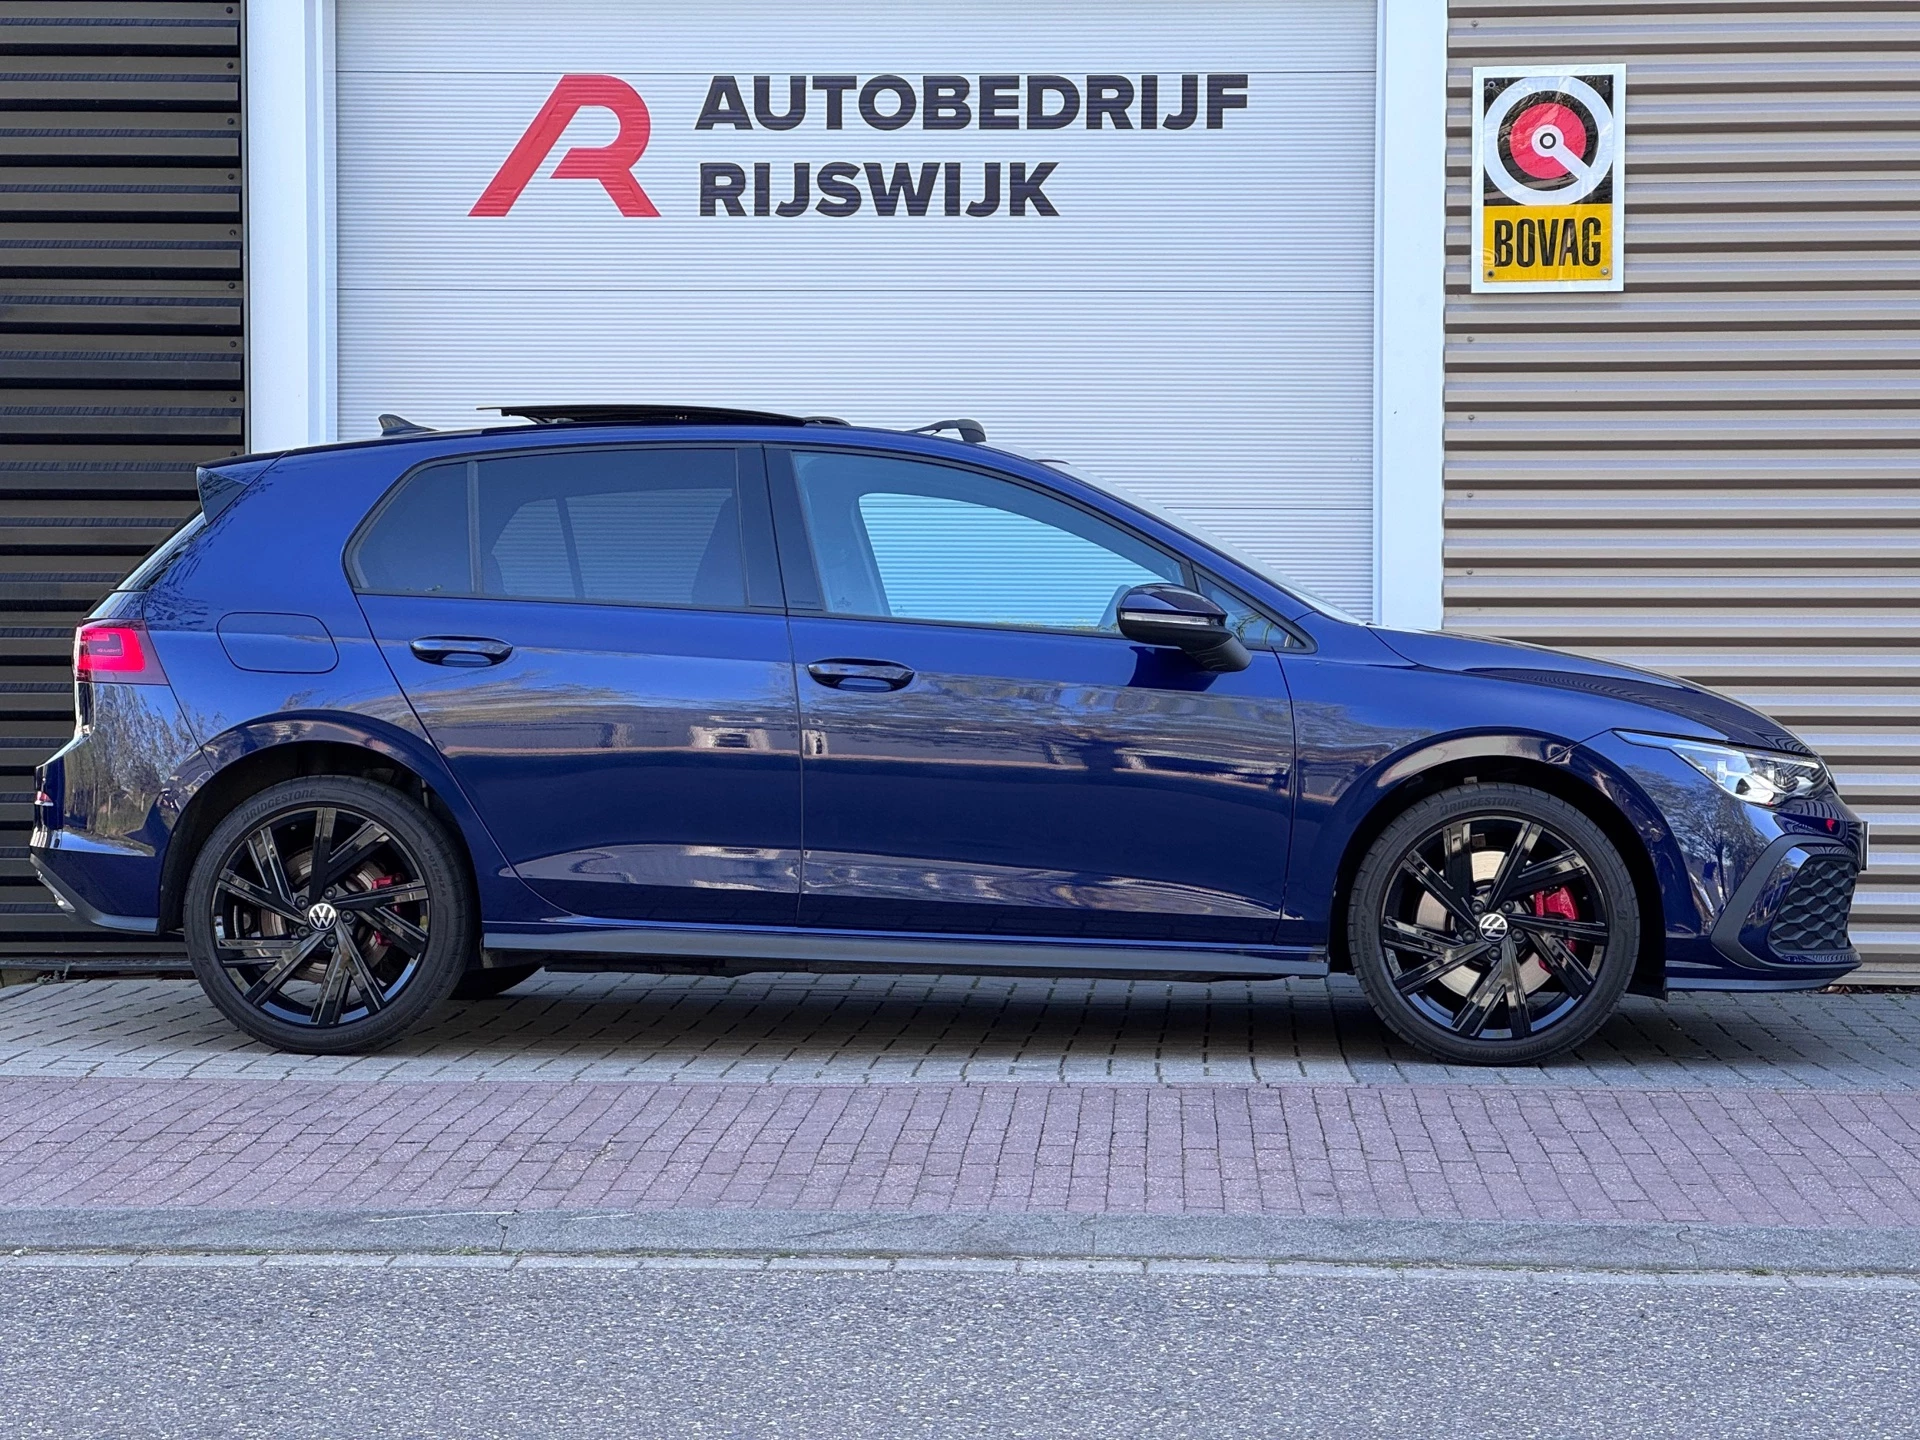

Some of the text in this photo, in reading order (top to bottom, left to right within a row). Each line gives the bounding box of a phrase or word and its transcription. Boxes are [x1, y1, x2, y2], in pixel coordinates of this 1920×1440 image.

[695, 75, 1248, 130] AUTOBEDRIJF
[700, 162, 1059, 217] RIJSWIJK
[1494, 217, 1602, 268] BOVAG
[240, 788, 317, 824] BRIDGESTONE
[1439, 796, 1523, 817] BRIDGESTONE
